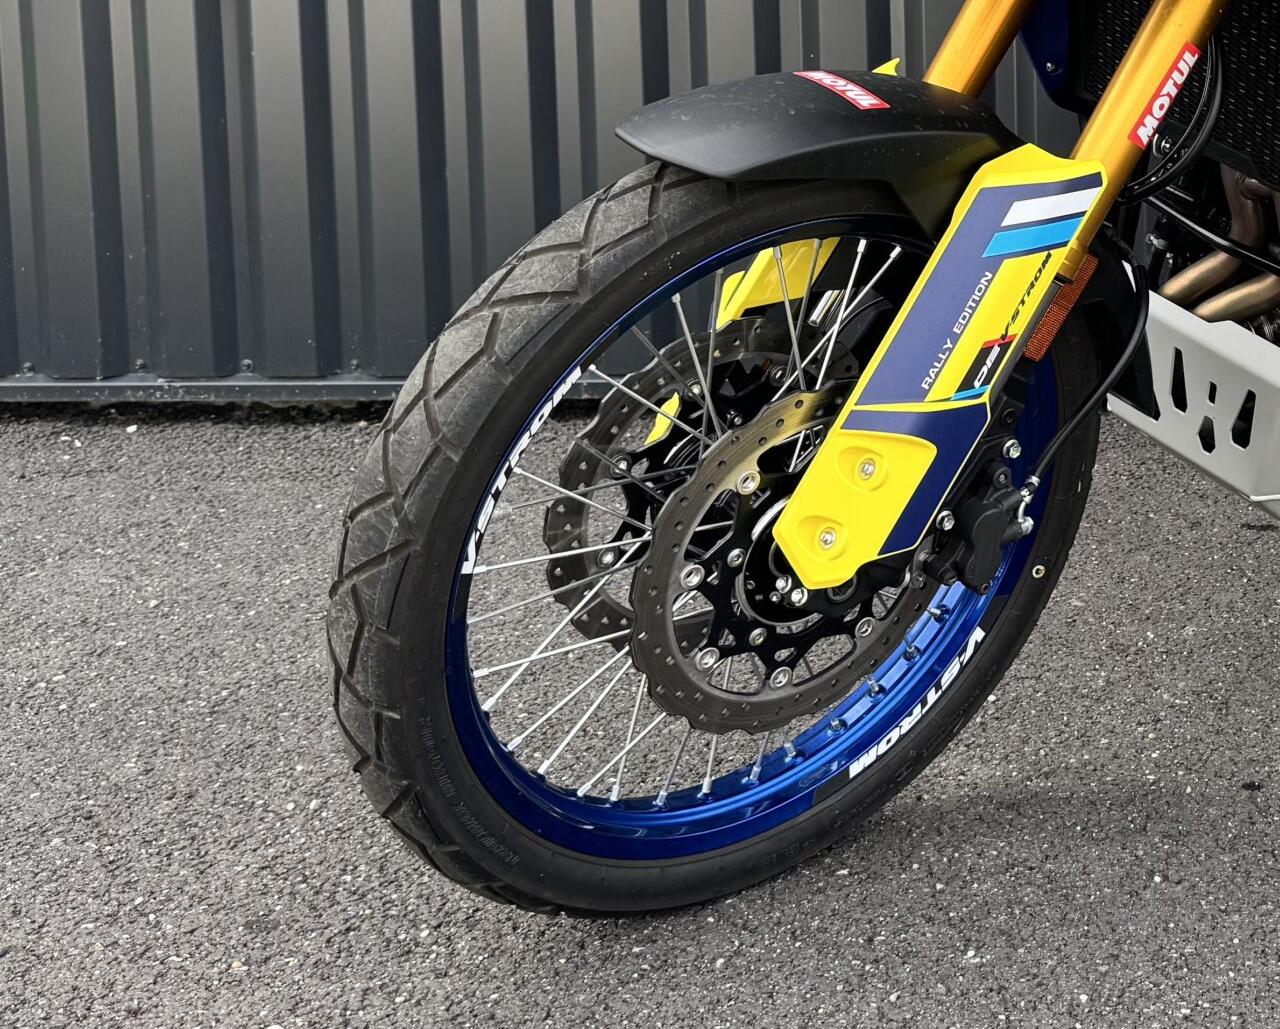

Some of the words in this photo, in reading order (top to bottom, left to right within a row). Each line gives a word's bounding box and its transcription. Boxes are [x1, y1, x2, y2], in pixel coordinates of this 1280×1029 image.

[806, 70, 881, 107] MOTUL
[1136, 50, 1199, 146] MOTUL
[921, 338, 953, 389] RALLY
[953, 271, 993, 334] EDITION
[973, 343, 1001, 388] DE
[1000, 251, 1052, 341] V-STROM
